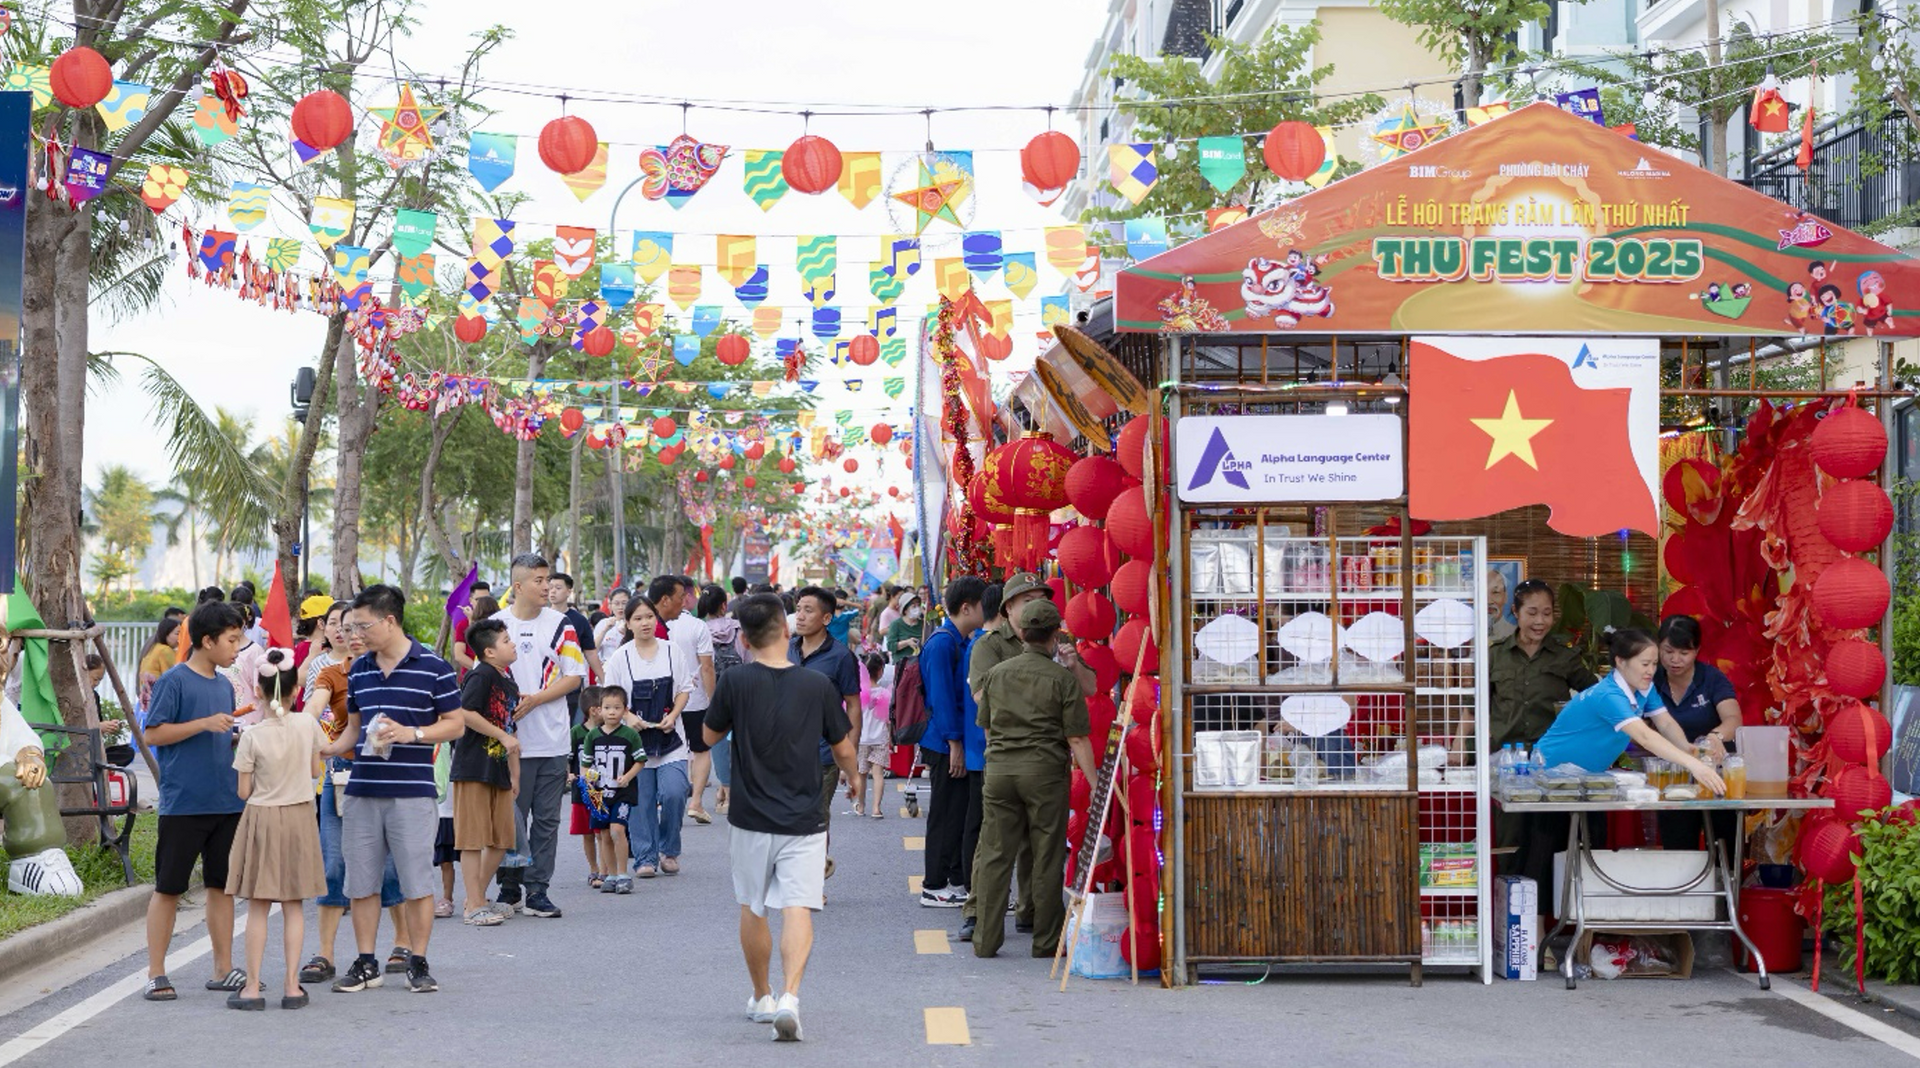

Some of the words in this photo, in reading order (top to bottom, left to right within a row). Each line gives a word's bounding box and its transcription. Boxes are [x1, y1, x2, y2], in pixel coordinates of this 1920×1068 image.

[1409, 165, 1472, 180] BIMGroup
[1386, 194, 1408, 226] LỄ
[1413, 199, 1443, 231] HỘI
[1449, 199, 1508, 226] TRĂNG
[1515, 197, 1554, 227] RẰM
[1560, 198, 1595, 227] LẦN
[1600, 200, 1639, 227] THỨ
[1643, 198, 1690, 227] NHẤT
[1373, 237, 1467, 281] THU
[1470, 237, 1581, 281] FEST
[1584, 237, 1704, 282] 2025
[1261, 453, 1295, 464] Alpha
[1299, 453, 1353, 464] Language
[1355, 452, 1391, 462] Center
[1264, 474, 1275, 483] In
[1279, 474, 1305, 483] Trust
[1309, 473, 1325, 483] We
[1328, 472, 1358, 483] Shine
[1511, 924, 1520, 971] SAPPHIRE
